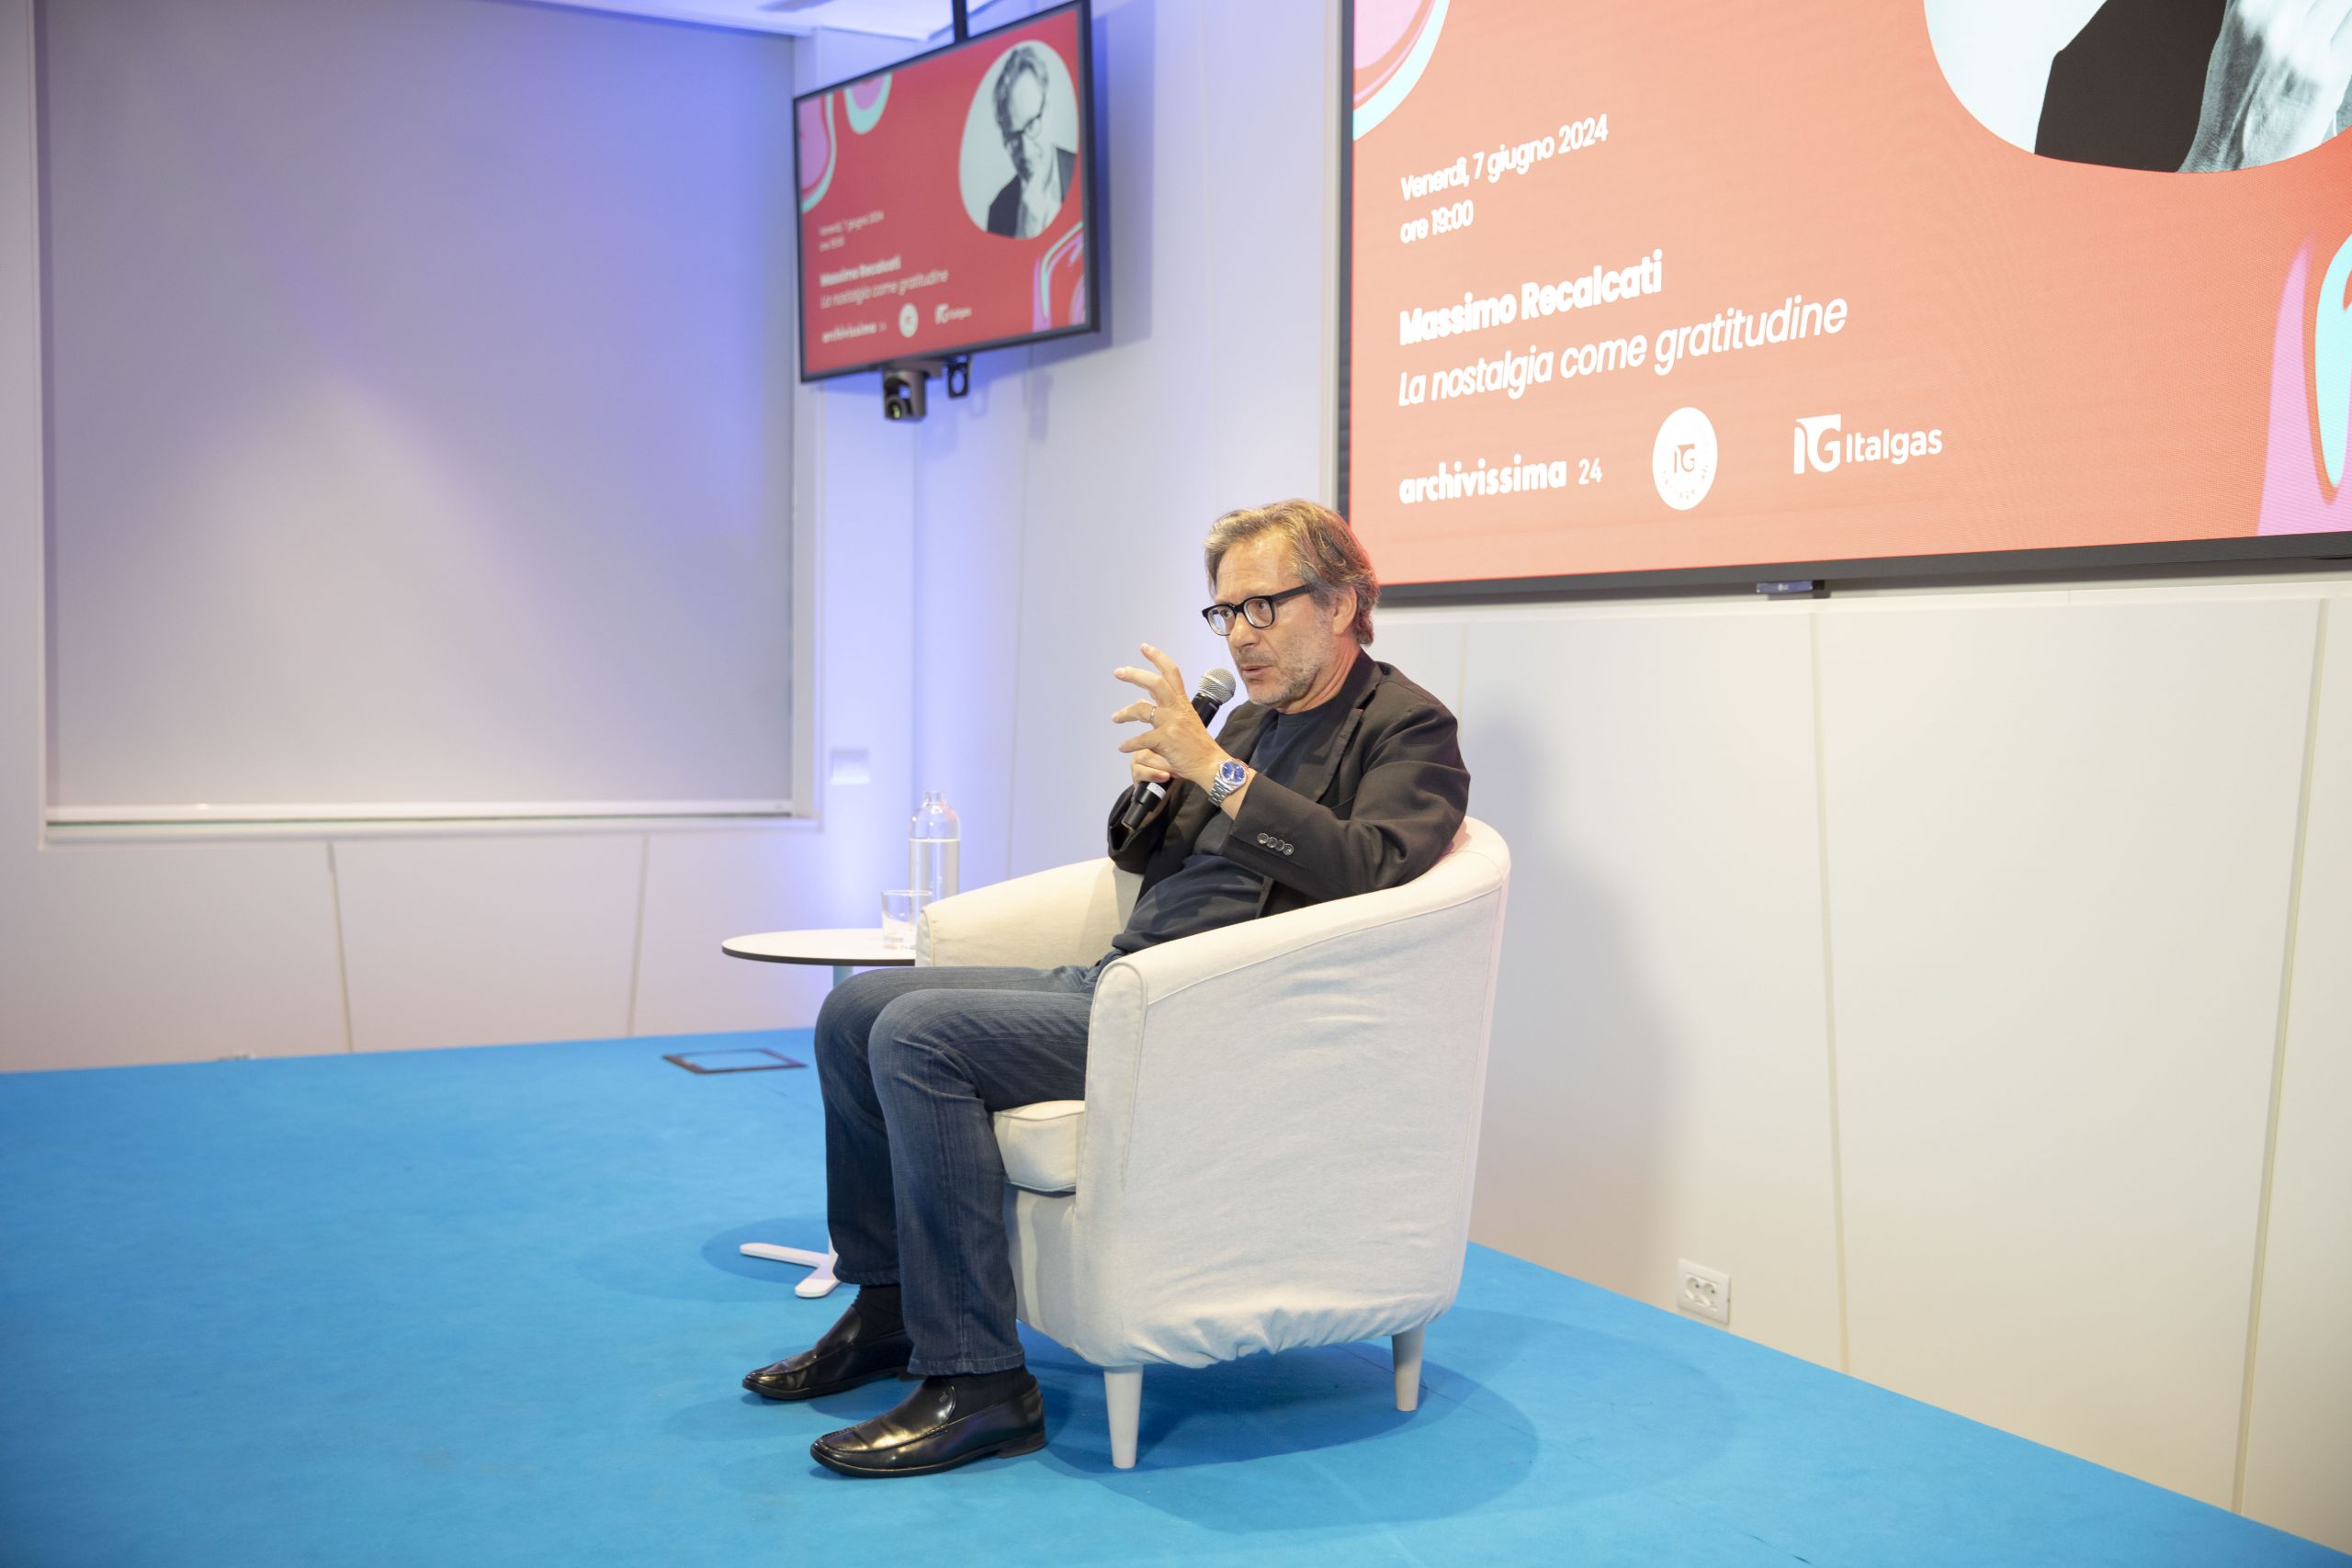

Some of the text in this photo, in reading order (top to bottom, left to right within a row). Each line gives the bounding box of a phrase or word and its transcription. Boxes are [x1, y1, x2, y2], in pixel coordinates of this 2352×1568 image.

[1400, 114, 1609, 200] Venerdì, 7 giugno 2024
[1400, 199, 1474, 243] ore 19:00
[1399, 249, 1662, 345] Massimo Recalcati
[1398, 295, 1848, 406] La nostalgia come gratitudine
[1399, 454, 1603, 504] archivissima 24
[1846, 429, 1943, 465] Italgas
